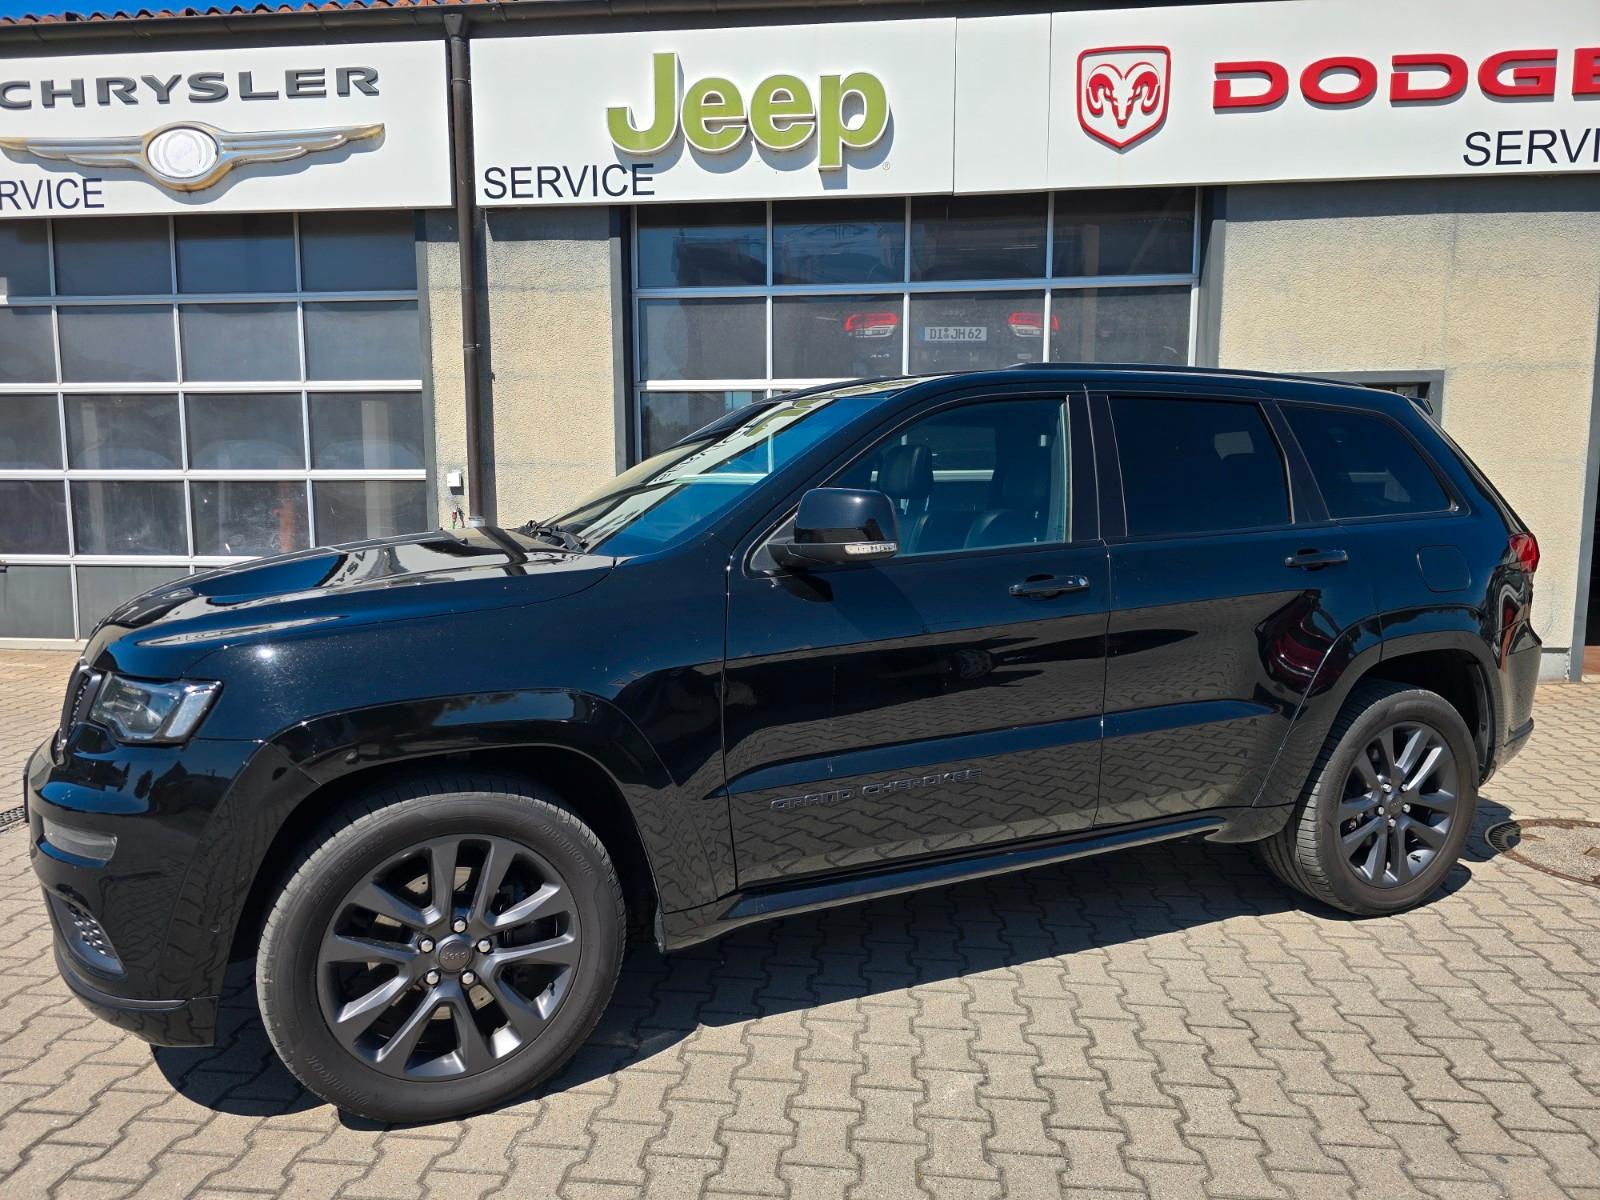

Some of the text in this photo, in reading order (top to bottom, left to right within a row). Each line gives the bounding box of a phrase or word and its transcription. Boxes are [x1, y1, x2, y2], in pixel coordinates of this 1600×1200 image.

[0, 66, 380, 109] CHRYSLER
[606, 51, 889, 171] Jeep
[1463, 128, 1600, 166] SERVI
[484, 163, 655, 199] SERVICE
[770, 788, 855, 810] GRAND
